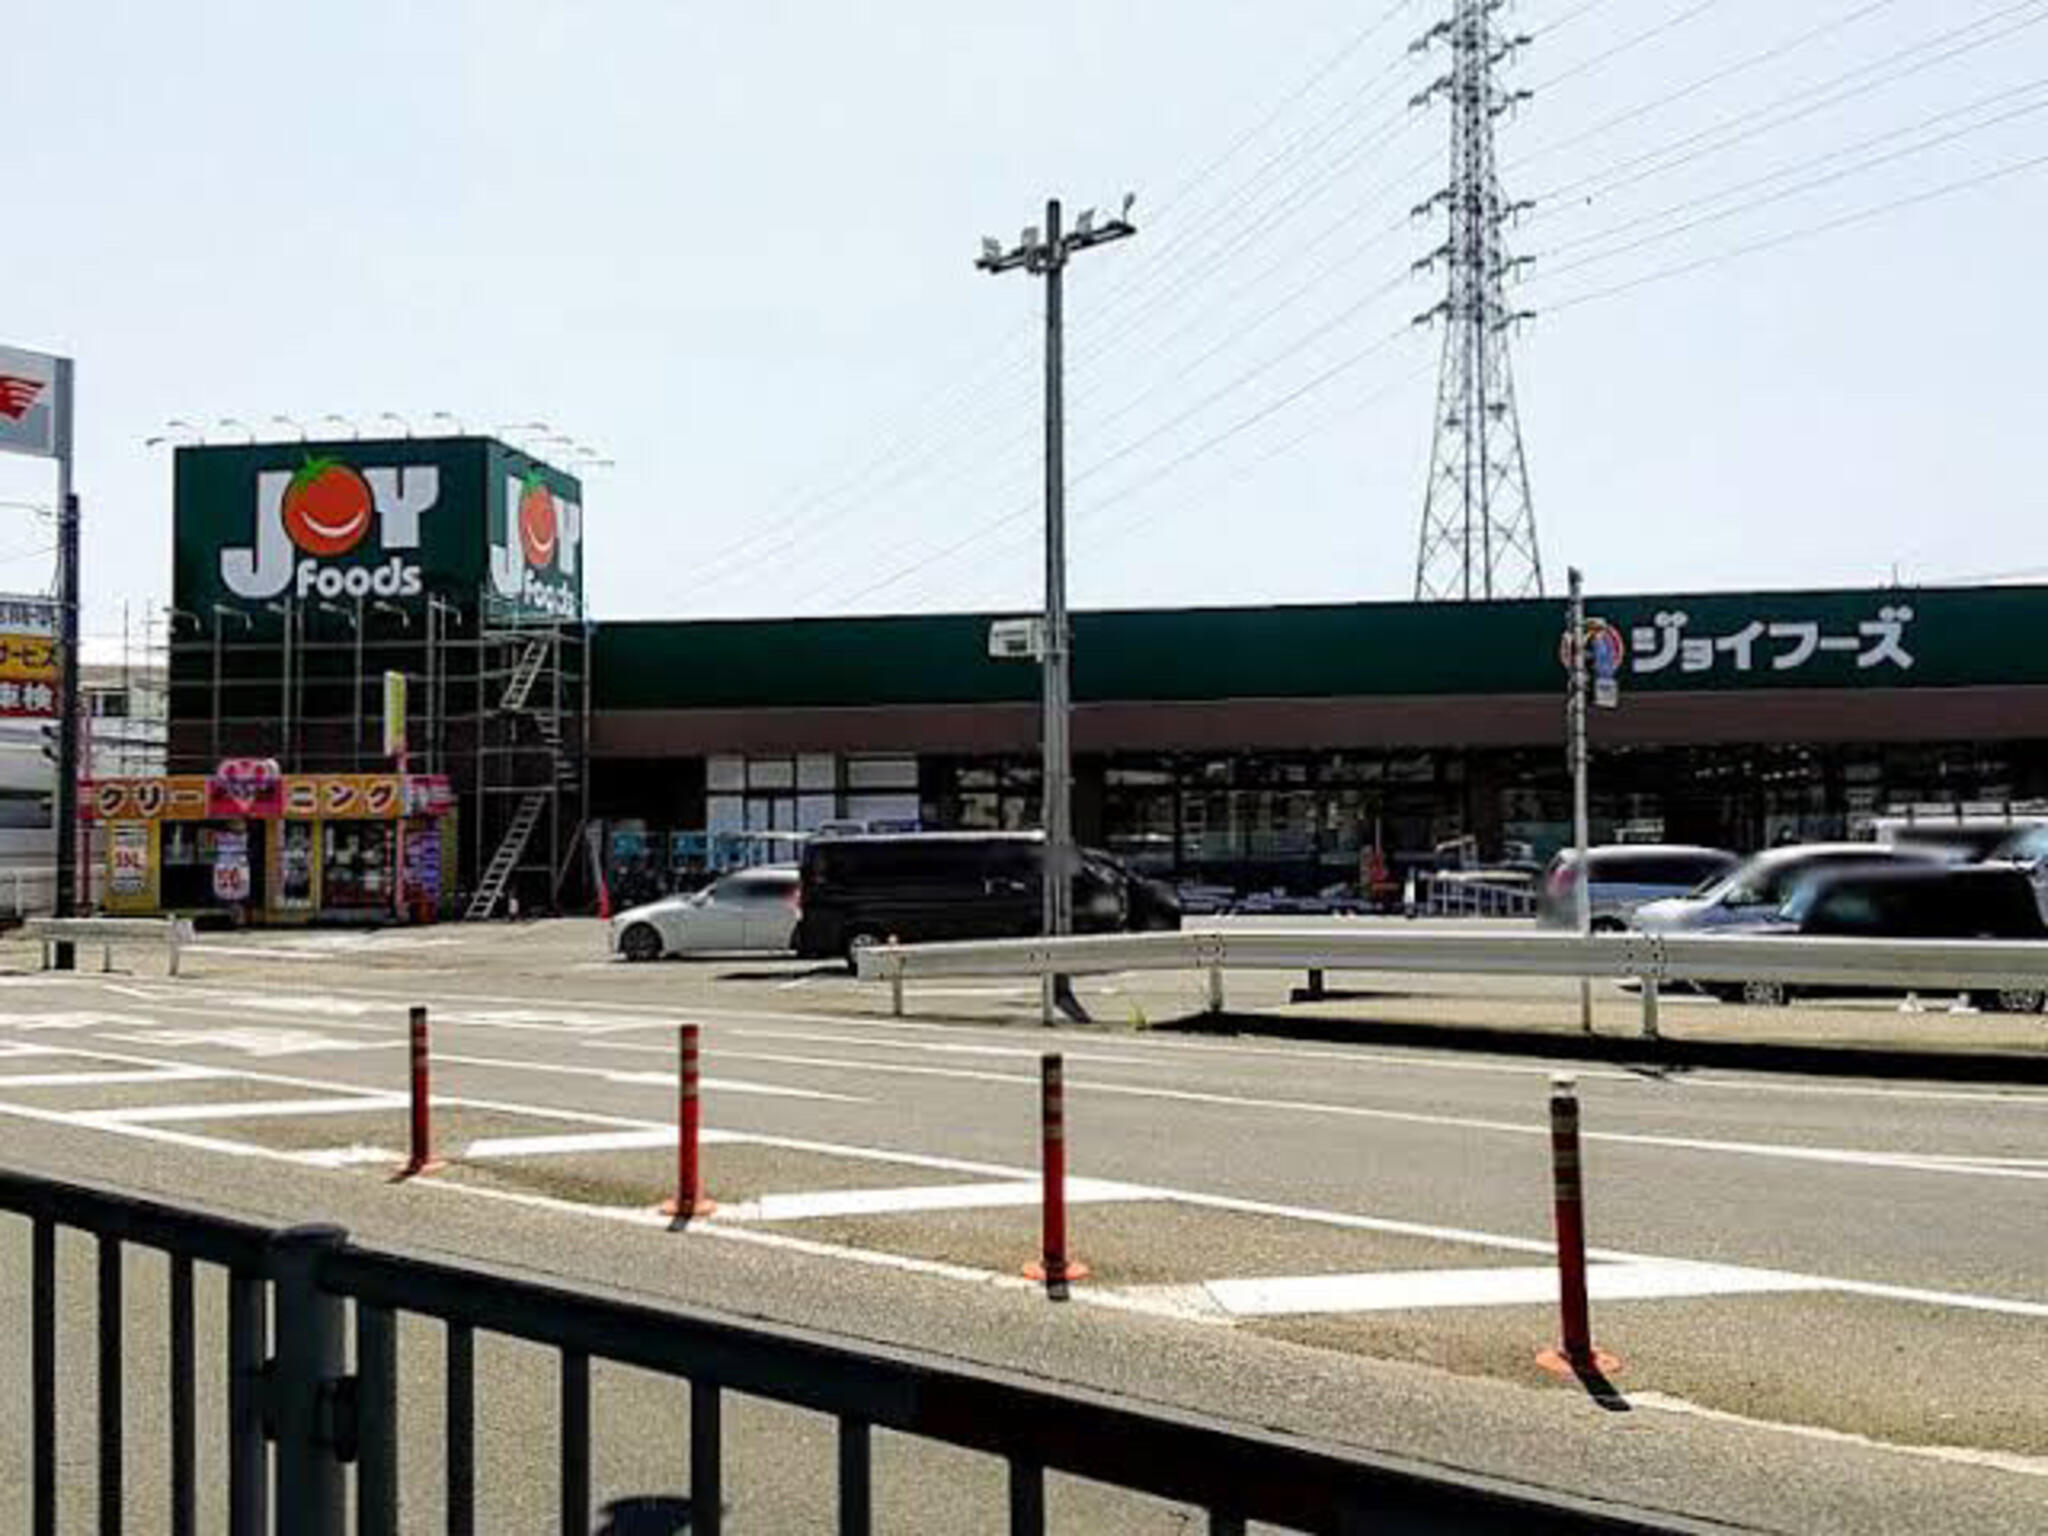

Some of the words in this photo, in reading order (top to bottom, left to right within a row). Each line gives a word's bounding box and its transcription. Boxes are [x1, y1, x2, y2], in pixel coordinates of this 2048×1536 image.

[220, 457, 439, 599] JOY
[297, 557, 422, 597] foods
[1632, 605, 1914, 673] ジョイフーズ
